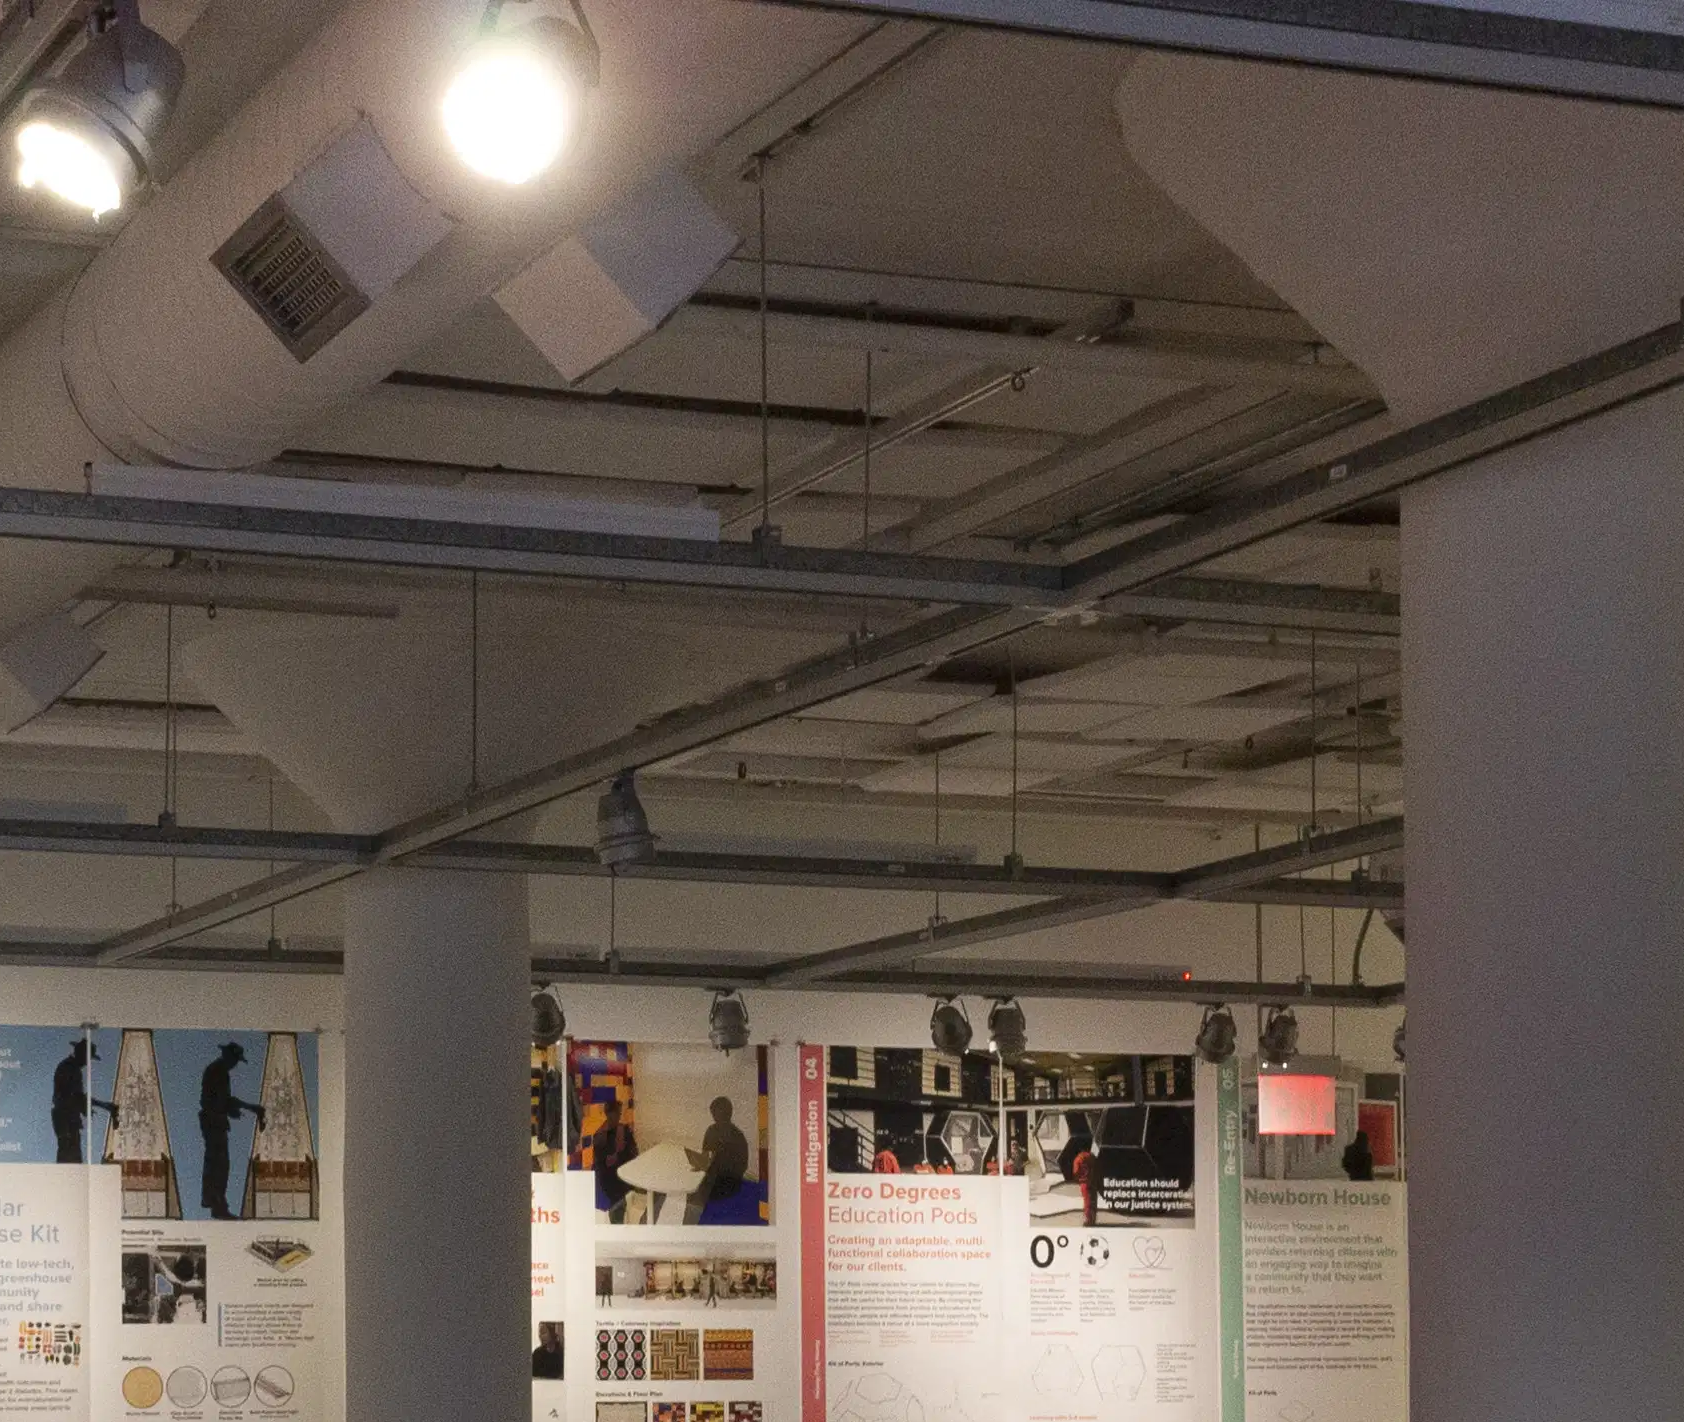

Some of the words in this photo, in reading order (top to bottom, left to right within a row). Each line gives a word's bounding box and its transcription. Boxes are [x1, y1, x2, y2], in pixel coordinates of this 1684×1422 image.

[805, 1100, 821, 1181] Mitigation
[1224, 1108, 1238, 1175] Re-Entry
[827, 1181, 873, 1199] Zero
[879, 1182, 962, 1204] Degrees
[1244, 1188, 1328, 1205] Newborn
[1333, 1189, 1391, 1206] House
[828, 1205, 924, 1224] Education
[931, 1206, 977, 1224] Pods
[30, 1223, 60, 1243] Kit
[827, 1260, 843, 1271] for
[845, 1263, 865, 1271] our
[867, 1260, 907, 1272] clients.
